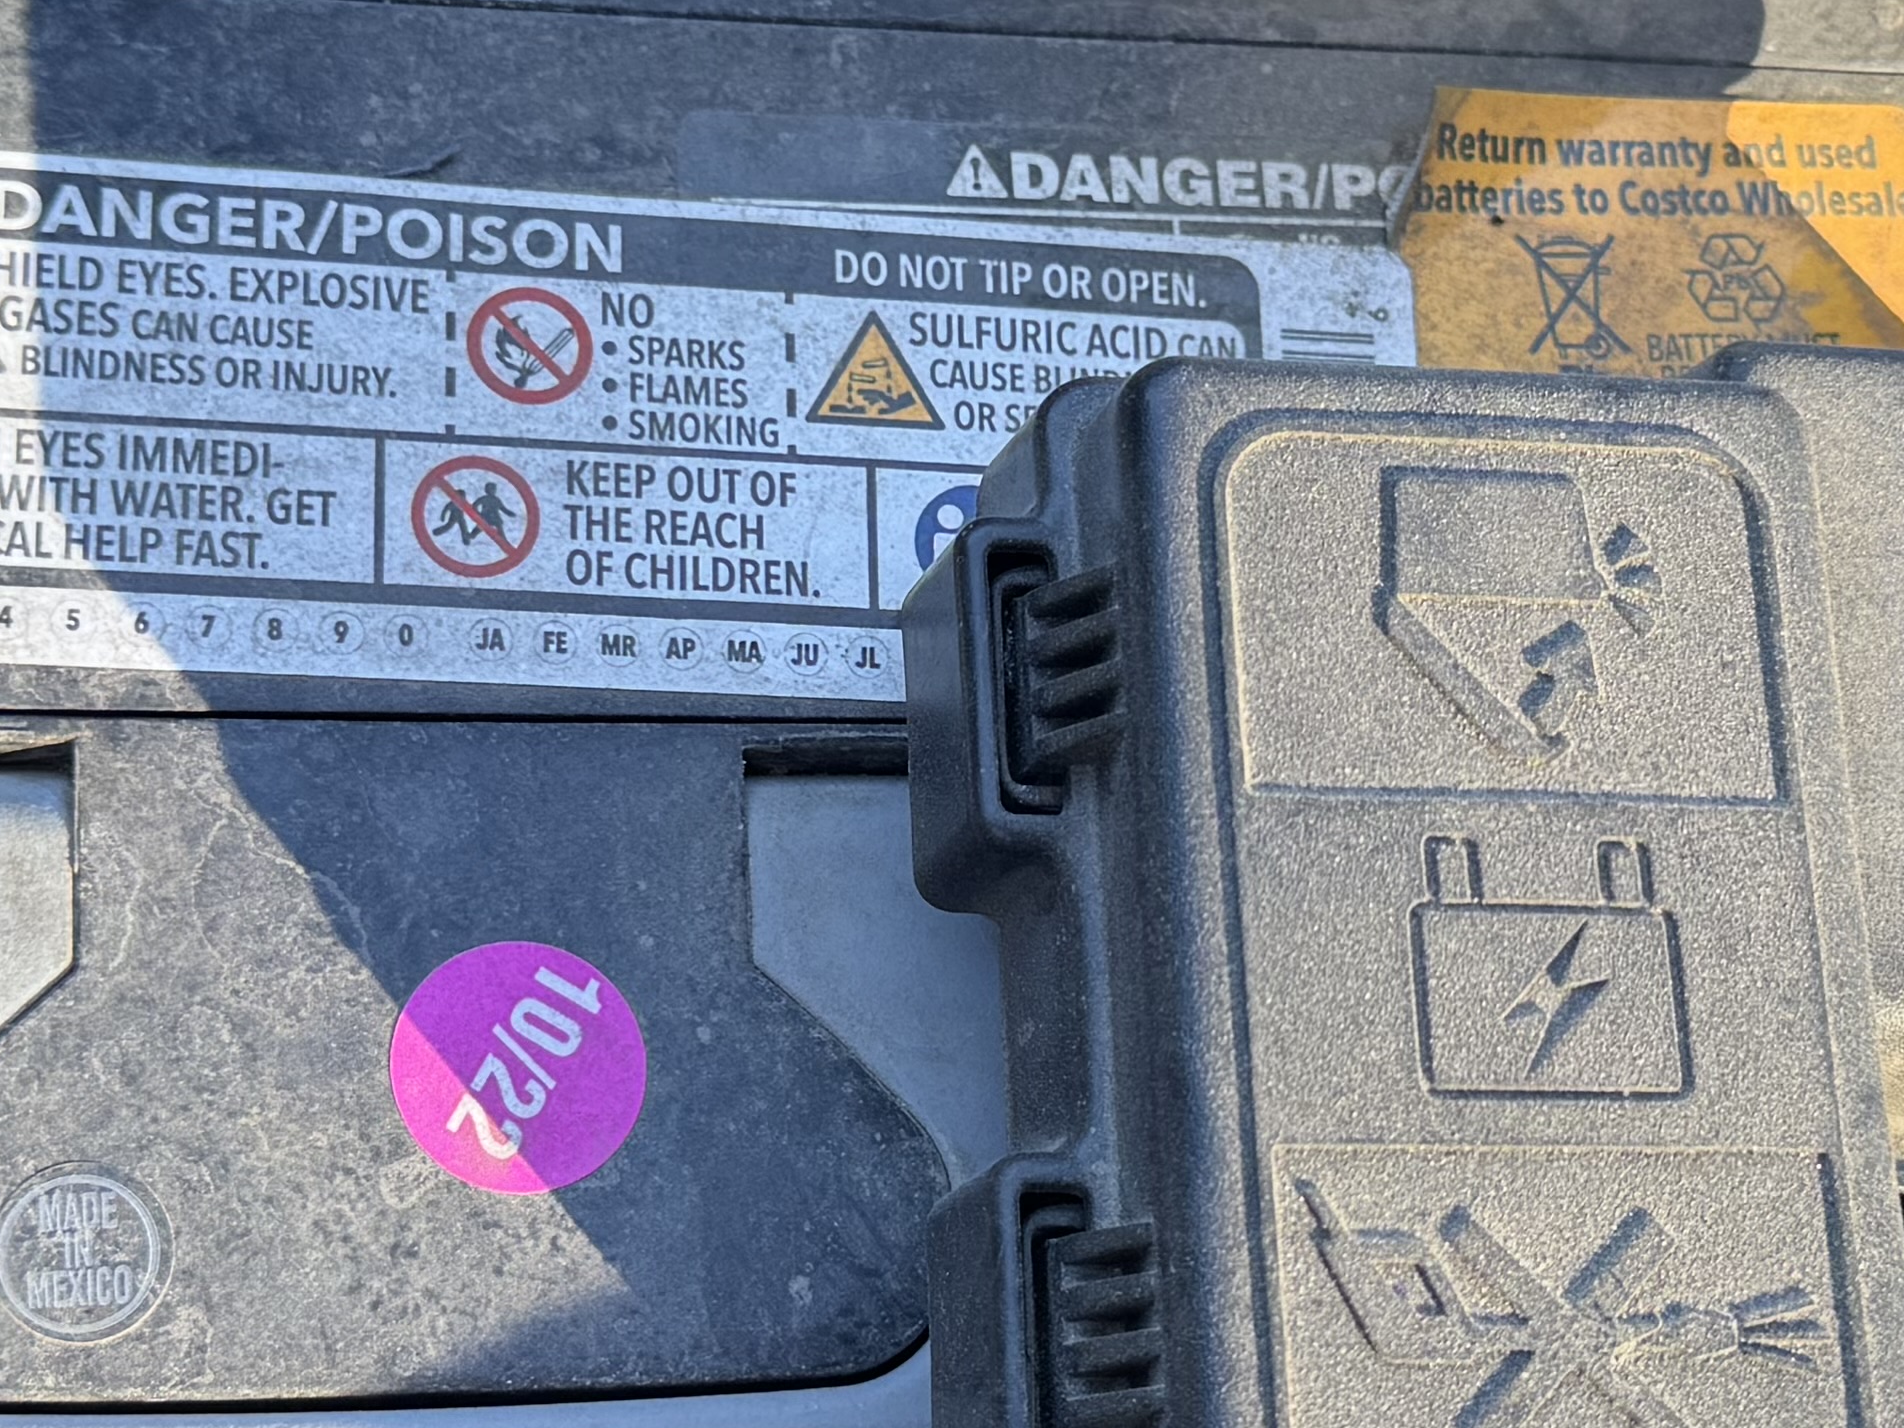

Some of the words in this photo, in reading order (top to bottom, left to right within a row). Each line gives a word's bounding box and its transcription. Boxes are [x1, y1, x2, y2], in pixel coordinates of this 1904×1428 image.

[1436, 122, 1546, 165] Return
[1556, 135, 1712, 176] warranty
[1724, 135, 1787, 171] and
[1796, 134, 1876, 170] used
[1413, 176, 1565, 217] batteries
[1574, 183, 1610, 216] to
[1618, 180, 1730, 217] Costco
[117, 258, 217, 302] EYES.
[230, 266, 430, 315] EXPLOSIVE
[834, 250, 888, 286] DO
[899, 254, 966, 292] NOT
[979, 259, 1033, 296] TIP
[1042, 263, 1094, 301] OR
[1102, 268, 1208, 310] OPEN.
[132, 308, 196, 343] CAN
[209, 314, 313, 350] CAUSE
[600, 291, 655, 329] NO
[628, 335, 746, 371] SPARKS
[908, 311, 1078, 357] SULFURIC
[1086, 323, 1168, 361] ACID
[1177, 333, 1236, 359] CAN
[1647, 333, 1741, 362] BATTE
[21, 345, 206, 389] BLINDNESS
[217, 357, 262, 389] OR
[272, 360, 396, 399] INJURY.
[628, 372, 748, 409] FLAMES
[929, 358, 1025, 394] CAUSE
[627, 410, 780, 449] SMOKING
[954, 401, 997, 433] OR
[15, 428, 106, 470] EYES
[118, 434, 285, 480] IMMEDI-
[111, 480, 255, 524] WATER.
[266, 489, 337, 528] GET
[565, 460, 656, 500] KEEP
[666, 467, 742, 504] OUT
[750, 472, 796, 507] OF
[64, 523, 162, 565] HELP
[175, 530, 270, 571] FAST.
[564, 503, 636, 545] THE
[644, 510, 765, 551] REACH
[565, 549, 613, 587] OF
[623, 552, 821, 599] CHILDREN.
[65, 609, 81, 631] 5
[134, 613, 150, 634] 6
[200, 614, 216, 638] 7
[267, 617, 283, 640] 8
[333, 620, 350, 643] 9
[398, 623, 414, 646] 0
[475, 626, 505, 650] JA
[543, 629, 568, 654] FE
[600, 632, 637, 657] MR
[665, 636, 697, 660] AP
[728, 639, 764, 663] MA
[790, 642, 820, 666] JU
[854, 646, 882, 670] JL
[446, 966, 602, 1160] 10/22
[38, 1190, 118, 1233] MADE
[64, 1232, 95, 1269] IN
[26, 1264, 134, 1310] MEXICO
